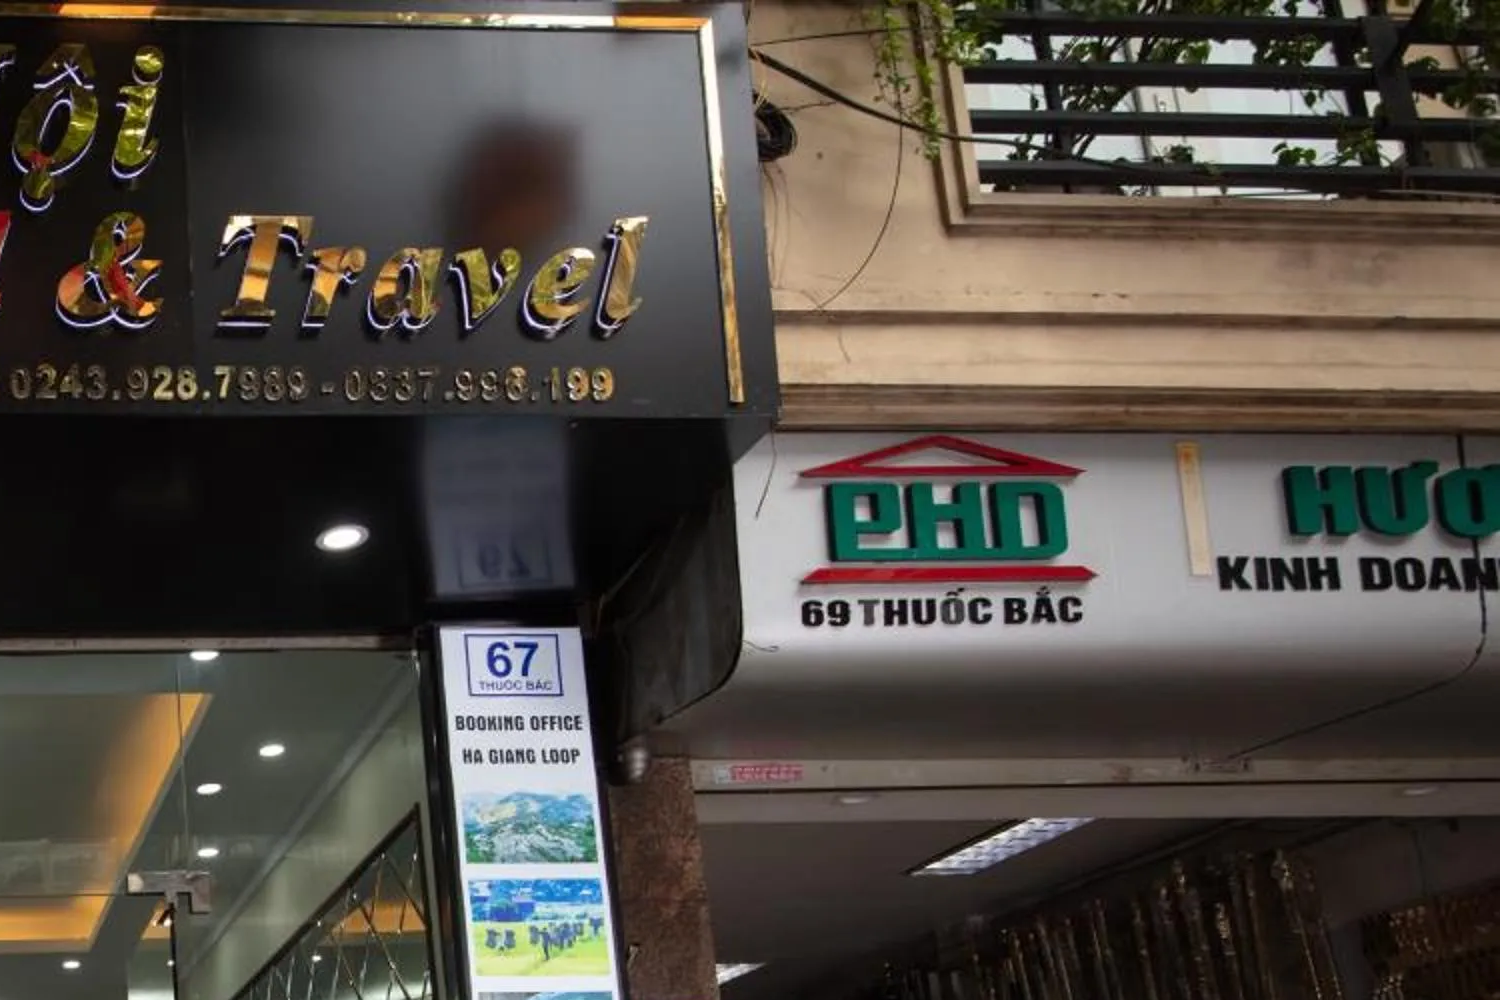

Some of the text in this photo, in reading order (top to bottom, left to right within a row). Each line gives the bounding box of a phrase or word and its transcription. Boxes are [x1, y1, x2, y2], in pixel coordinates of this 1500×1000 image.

[55, 210, 163, 330] &
[216, 213, 652, 338] Travel
[823, 480, 1071, 562] PHD
[1216, 556, 1500, 591] KINH DOAN
[800, 586, 1084, 629] 69 THUỐC BẮC
[486, 641, 539, 678] 67
[455, 715, 584, 731] BOOKING OFFICE
[462, 748, 582, 765] HA GIANG LOOP
